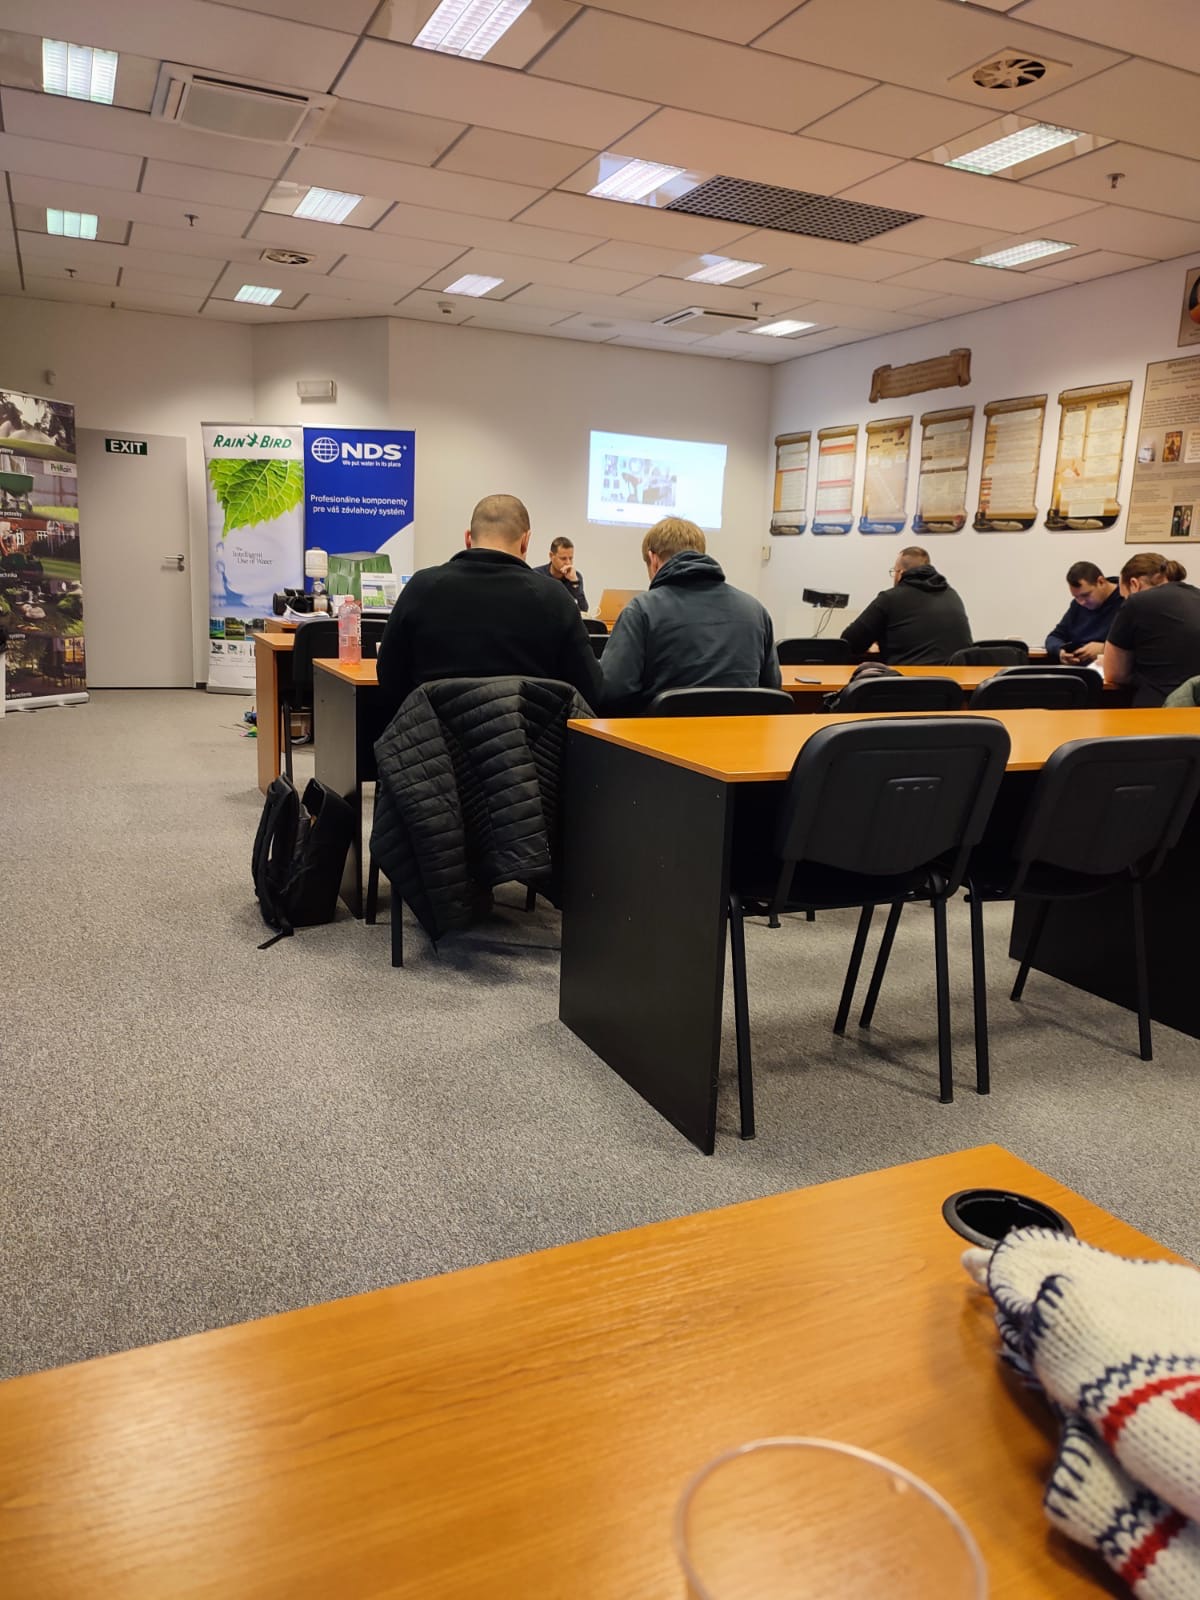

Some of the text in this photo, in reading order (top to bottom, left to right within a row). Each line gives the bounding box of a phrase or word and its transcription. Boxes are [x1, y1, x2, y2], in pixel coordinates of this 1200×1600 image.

[109, 440, 144, 455] EXIT
[213, 434, 292, 449] RAIN BIRD
[341, 442, 402, 461] NDS
[310, 494, 408, 507] Profesionálne komponenty
[313, 505, 405, 517] pre váš závlahový systém
